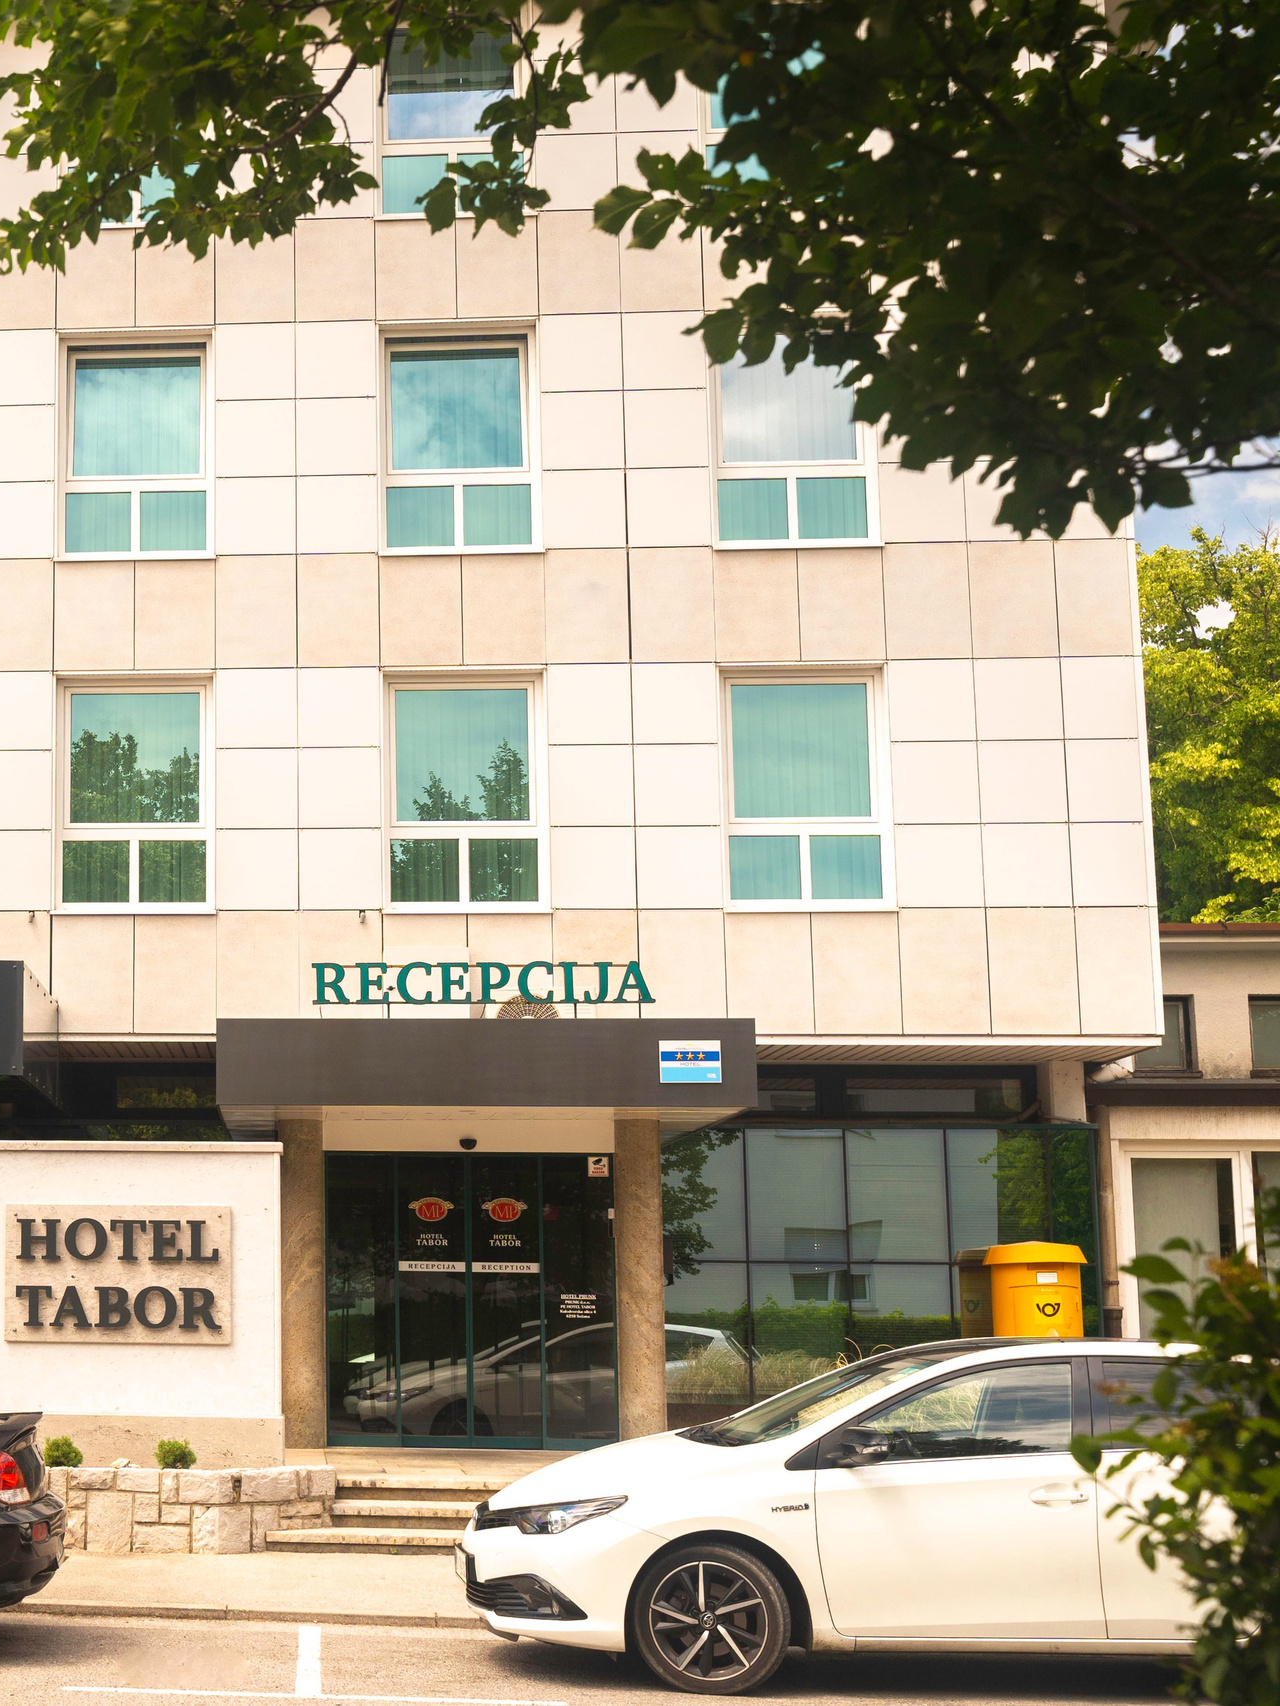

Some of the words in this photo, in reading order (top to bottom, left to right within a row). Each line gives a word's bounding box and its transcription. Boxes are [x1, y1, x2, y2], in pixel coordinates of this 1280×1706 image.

[311, 960, 656, 1005] RECEPCIJA
[421, 1204, 444, 1218] MP
[494, 1205, 518, 1218] MP
[15, 1217, 219, 1262] HOTEL
[489, 1239, 522, 1247] TABOR
[15, 1285, 222, 1329] TABOR
[771, 1504, 804, 1513] HYBRID
